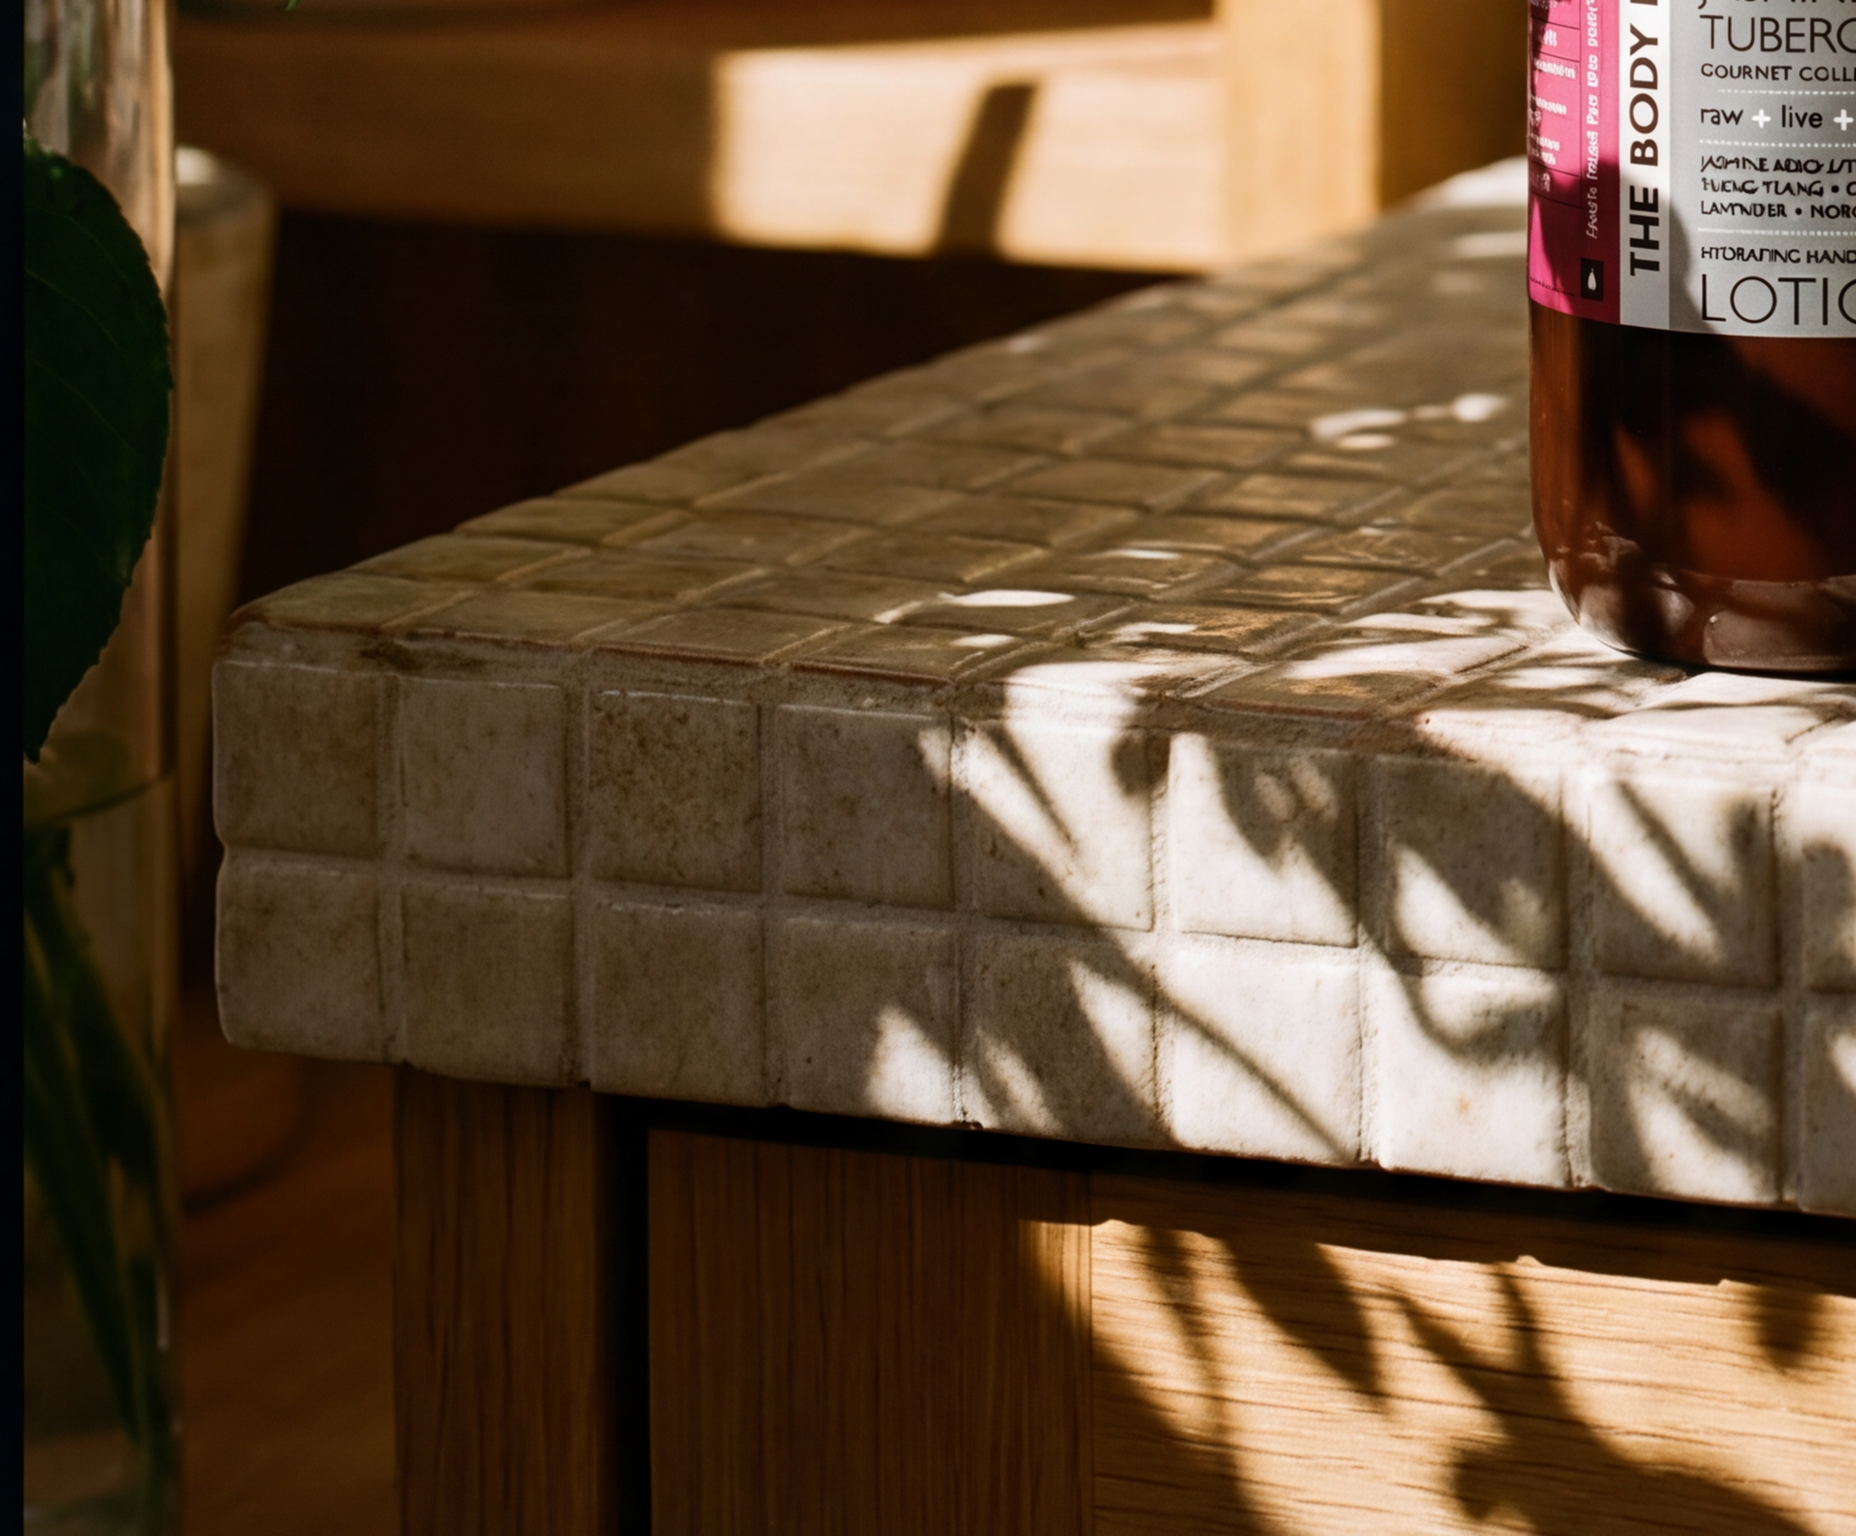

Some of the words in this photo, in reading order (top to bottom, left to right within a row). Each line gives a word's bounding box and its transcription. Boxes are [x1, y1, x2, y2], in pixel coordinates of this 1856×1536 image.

[1629, 22, 1660, 167] BODY
[1701, 108, 1744, 126] raw
[1781, 104, 1823, 128] live
[1629, 185, 1660, 276] THE
